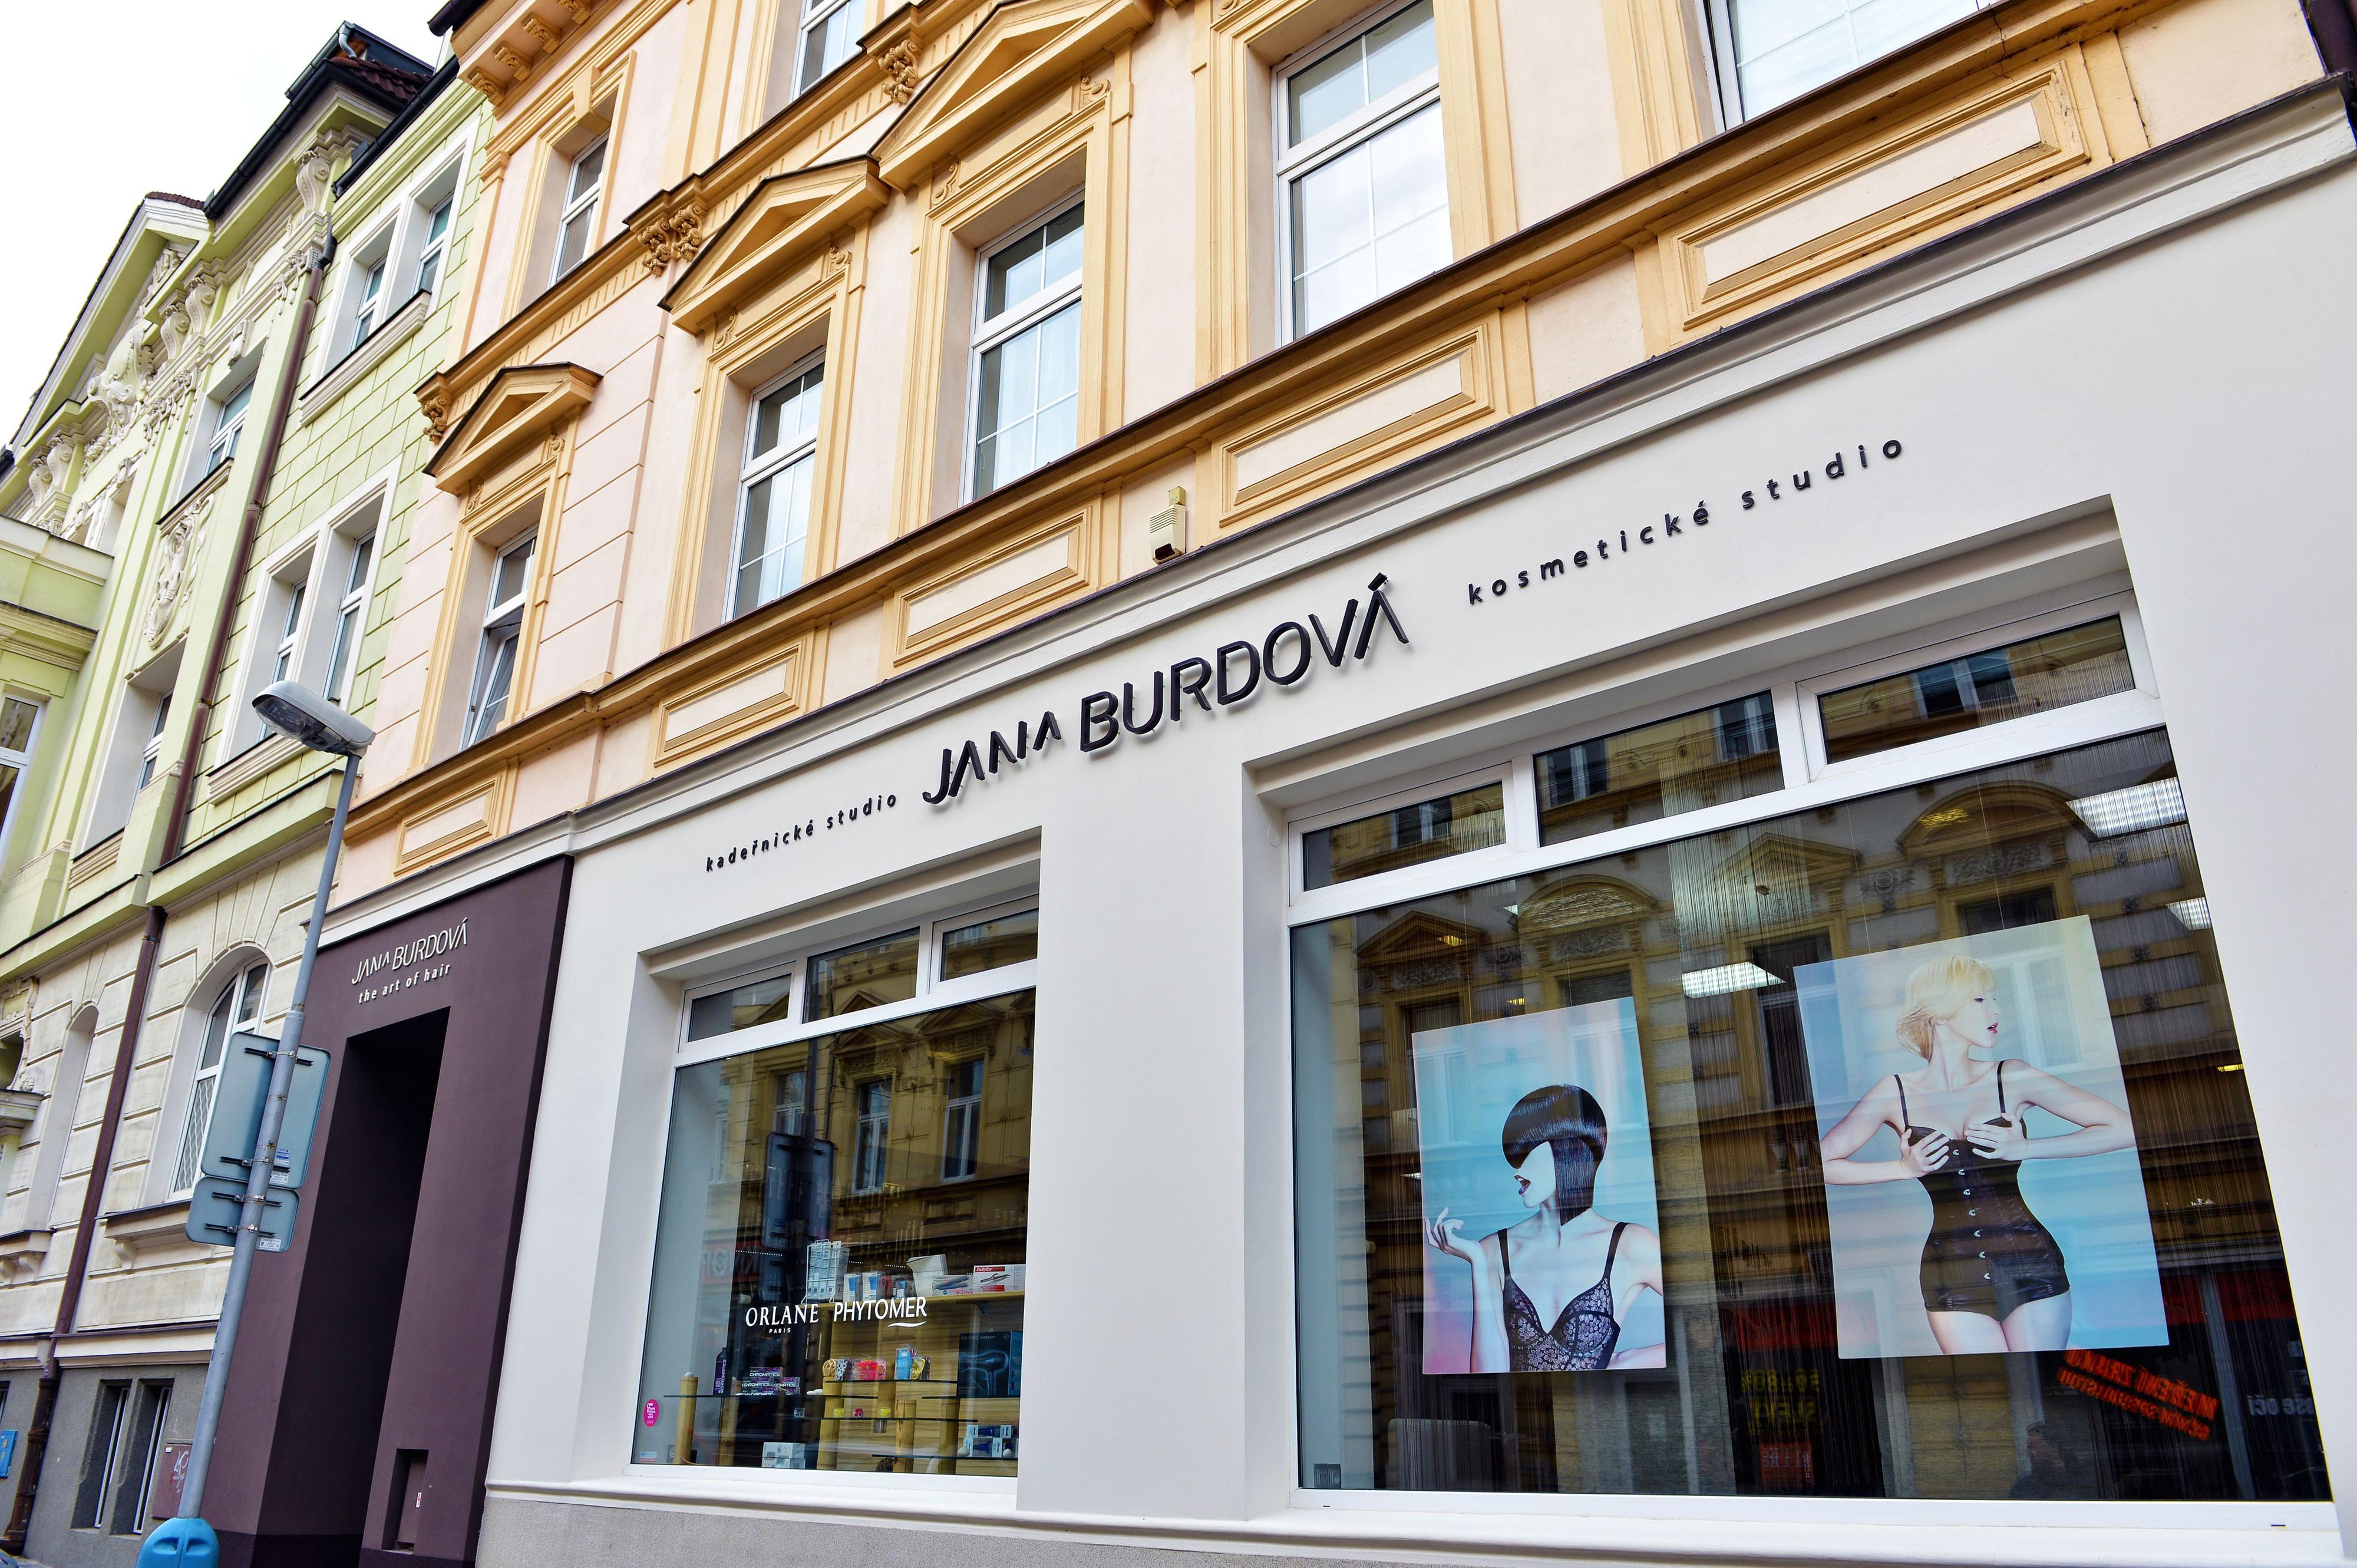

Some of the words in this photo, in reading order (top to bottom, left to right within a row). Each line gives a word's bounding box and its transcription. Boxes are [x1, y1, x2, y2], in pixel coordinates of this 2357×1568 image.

[1467, 500, 1709, 605] kosmetické
[1741, 439, 1902, 509] studio
[922, 711, 1062, 805] JANA
[1080, 572, 1409, 752] BURDOVÁ
[706, 819, 814, 872] kadeřnické
[826, 794, 896, 830] studio
[352, 951, 390, 985] JANA
[392, 917, 468, 970] BURDOVÁ
[359, 989, 377, 1003] the
[382, 979, 401, 996] art
[405, 971, 420, 988] of
[424, 963, 451, 982] hair
[745, 1303, 819, 1326] ORLANE
[834, 1296, 927, 1322] PHYTOMER
